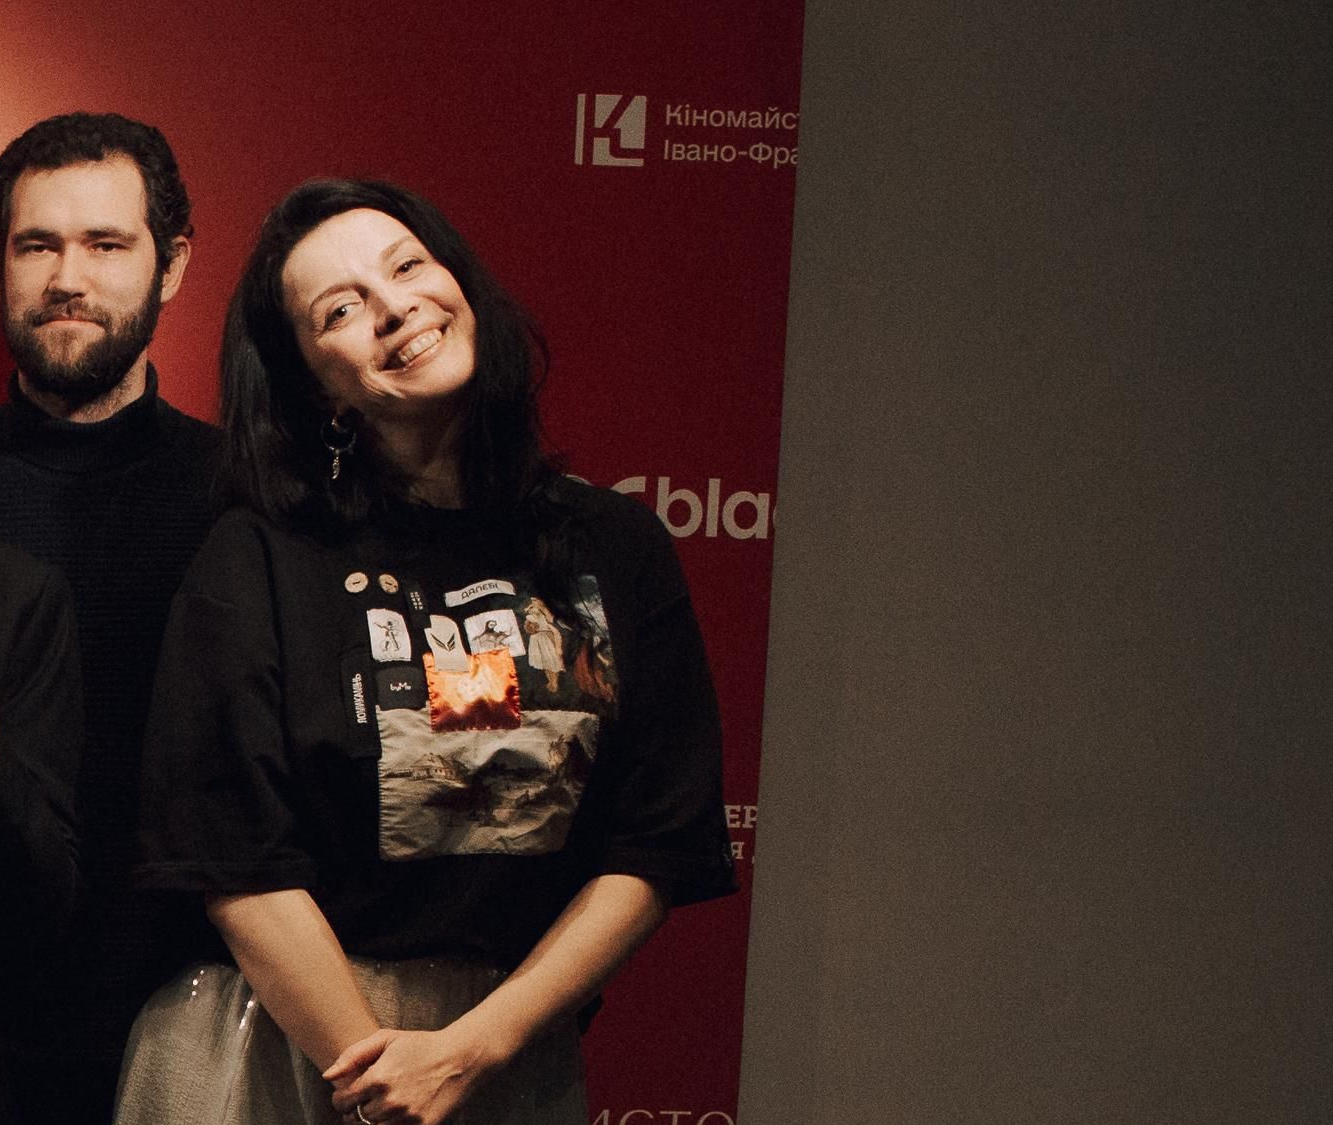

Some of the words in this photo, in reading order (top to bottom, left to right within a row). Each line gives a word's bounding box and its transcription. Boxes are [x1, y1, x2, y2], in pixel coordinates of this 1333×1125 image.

[665, 103, 801, 130] Кіномайс
[663, 139, 799, 169] Івано-Фра
[656, 475, 776, 540] bla
